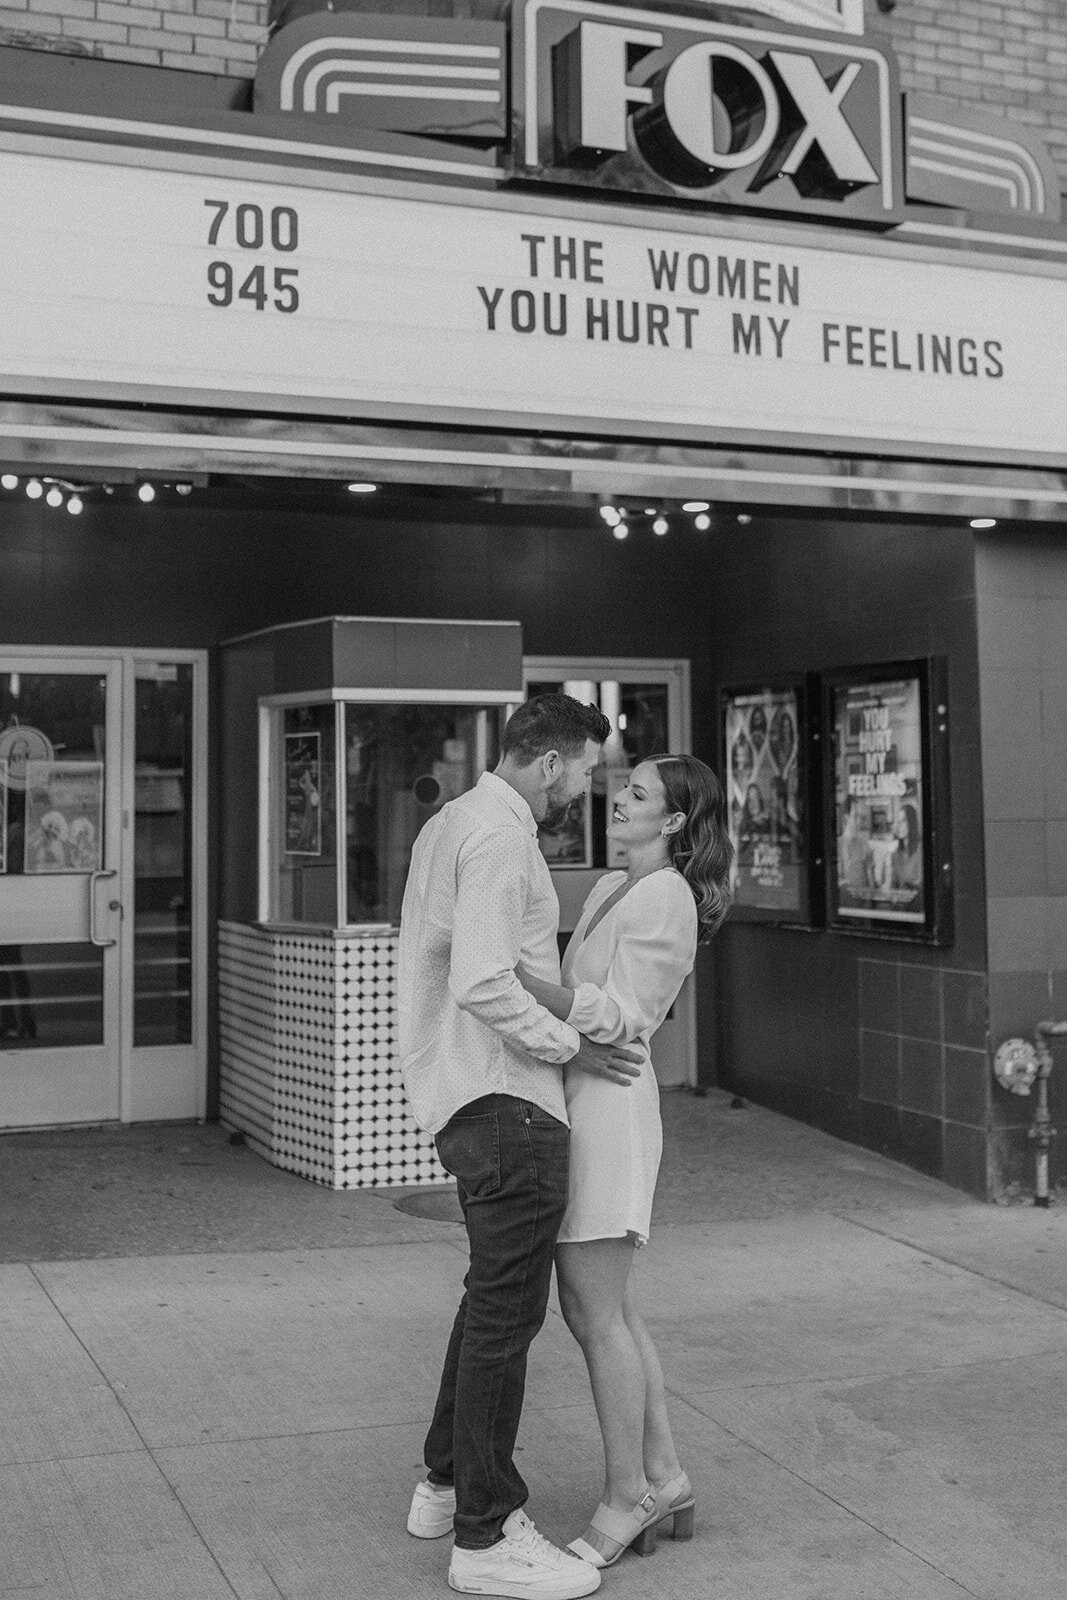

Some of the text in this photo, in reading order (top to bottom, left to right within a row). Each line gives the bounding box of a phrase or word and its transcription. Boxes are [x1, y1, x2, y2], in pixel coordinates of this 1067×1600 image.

[579, 20, 879, 185] FOX
[203, 199, 299, 252] 700
[206, 261, 300, 314] 945
[520, 233, 800, 306] THE WOMEN
[477, 286, 1004, 378] YOU HURT MY FEELINGS
[859, 729, 892, 753] HURT
[863, 707, 889, 730] YOU
[848, 772, 907, 797] FEELINGS
[865, 752, 887, 775] MY
